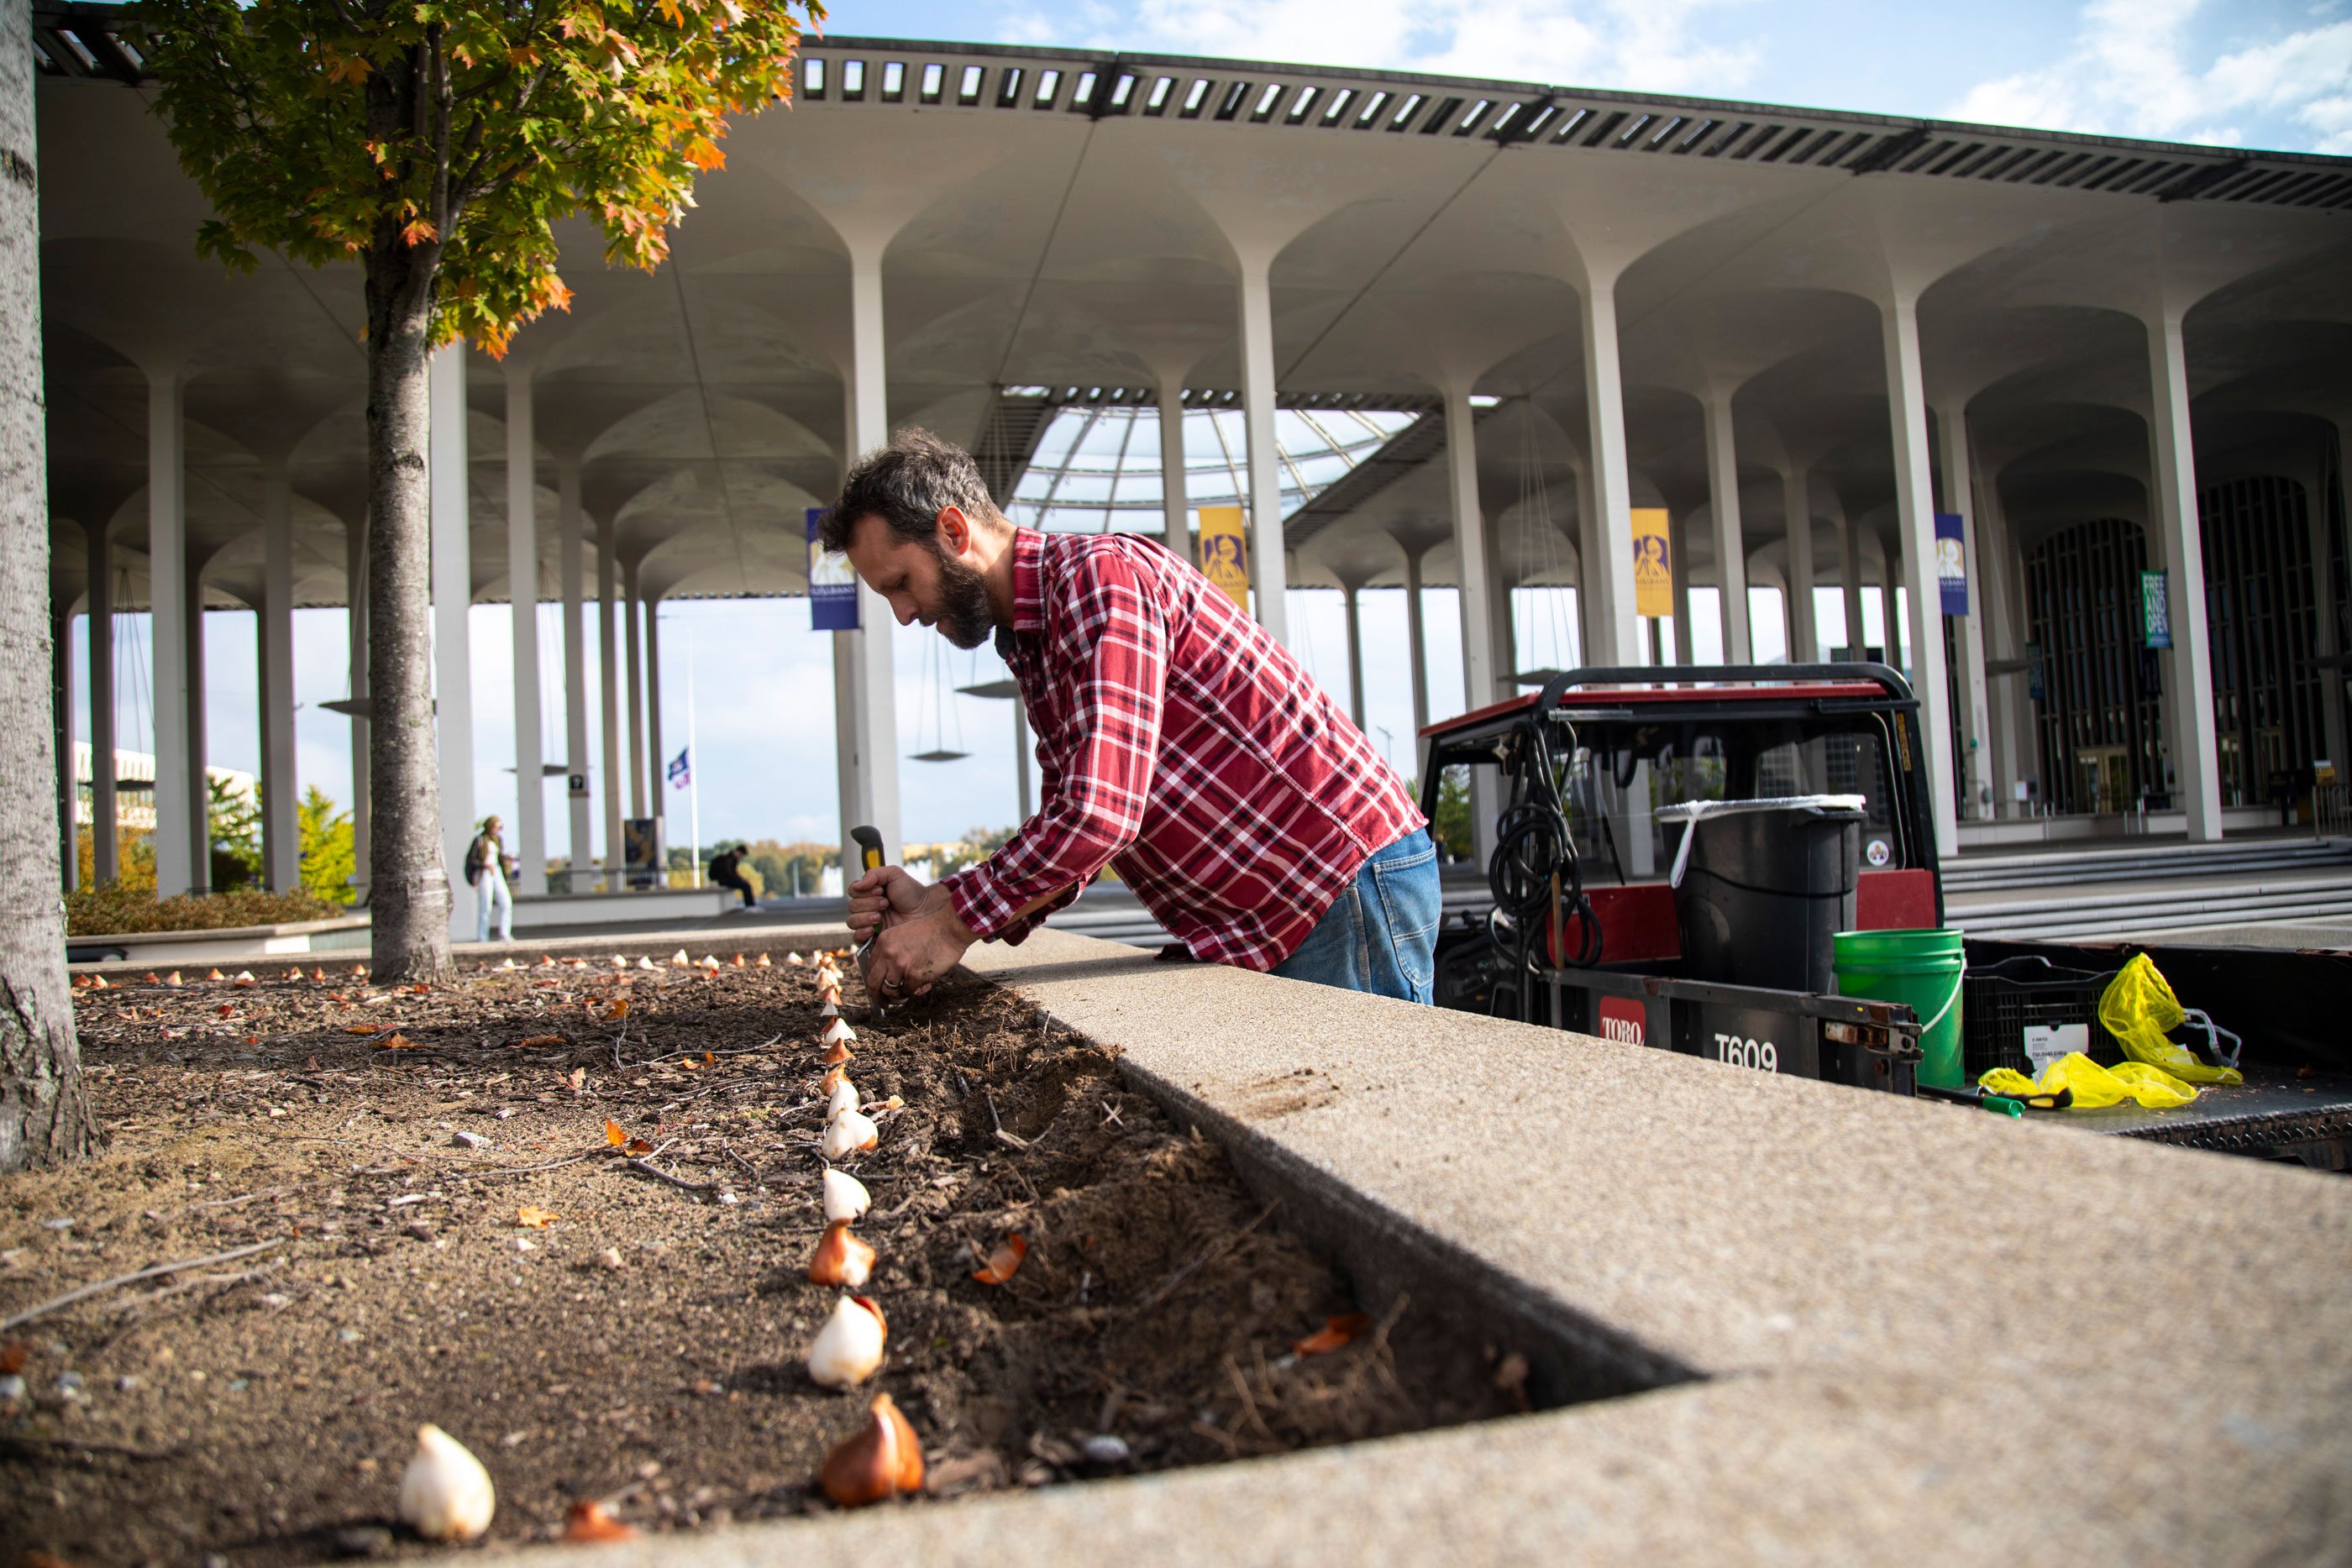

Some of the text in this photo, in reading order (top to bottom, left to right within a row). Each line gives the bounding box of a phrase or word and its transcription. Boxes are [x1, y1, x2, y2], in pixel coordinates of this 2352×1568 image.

[2144, 574, 2165, 595] FREE
[2146, 595, 2166, 615] AND
[2147, 614, 2169, 633] OPEN
[1603, 1017, 1642, 1046] TORO
[1714, 1033, 1777, 1073] T609
